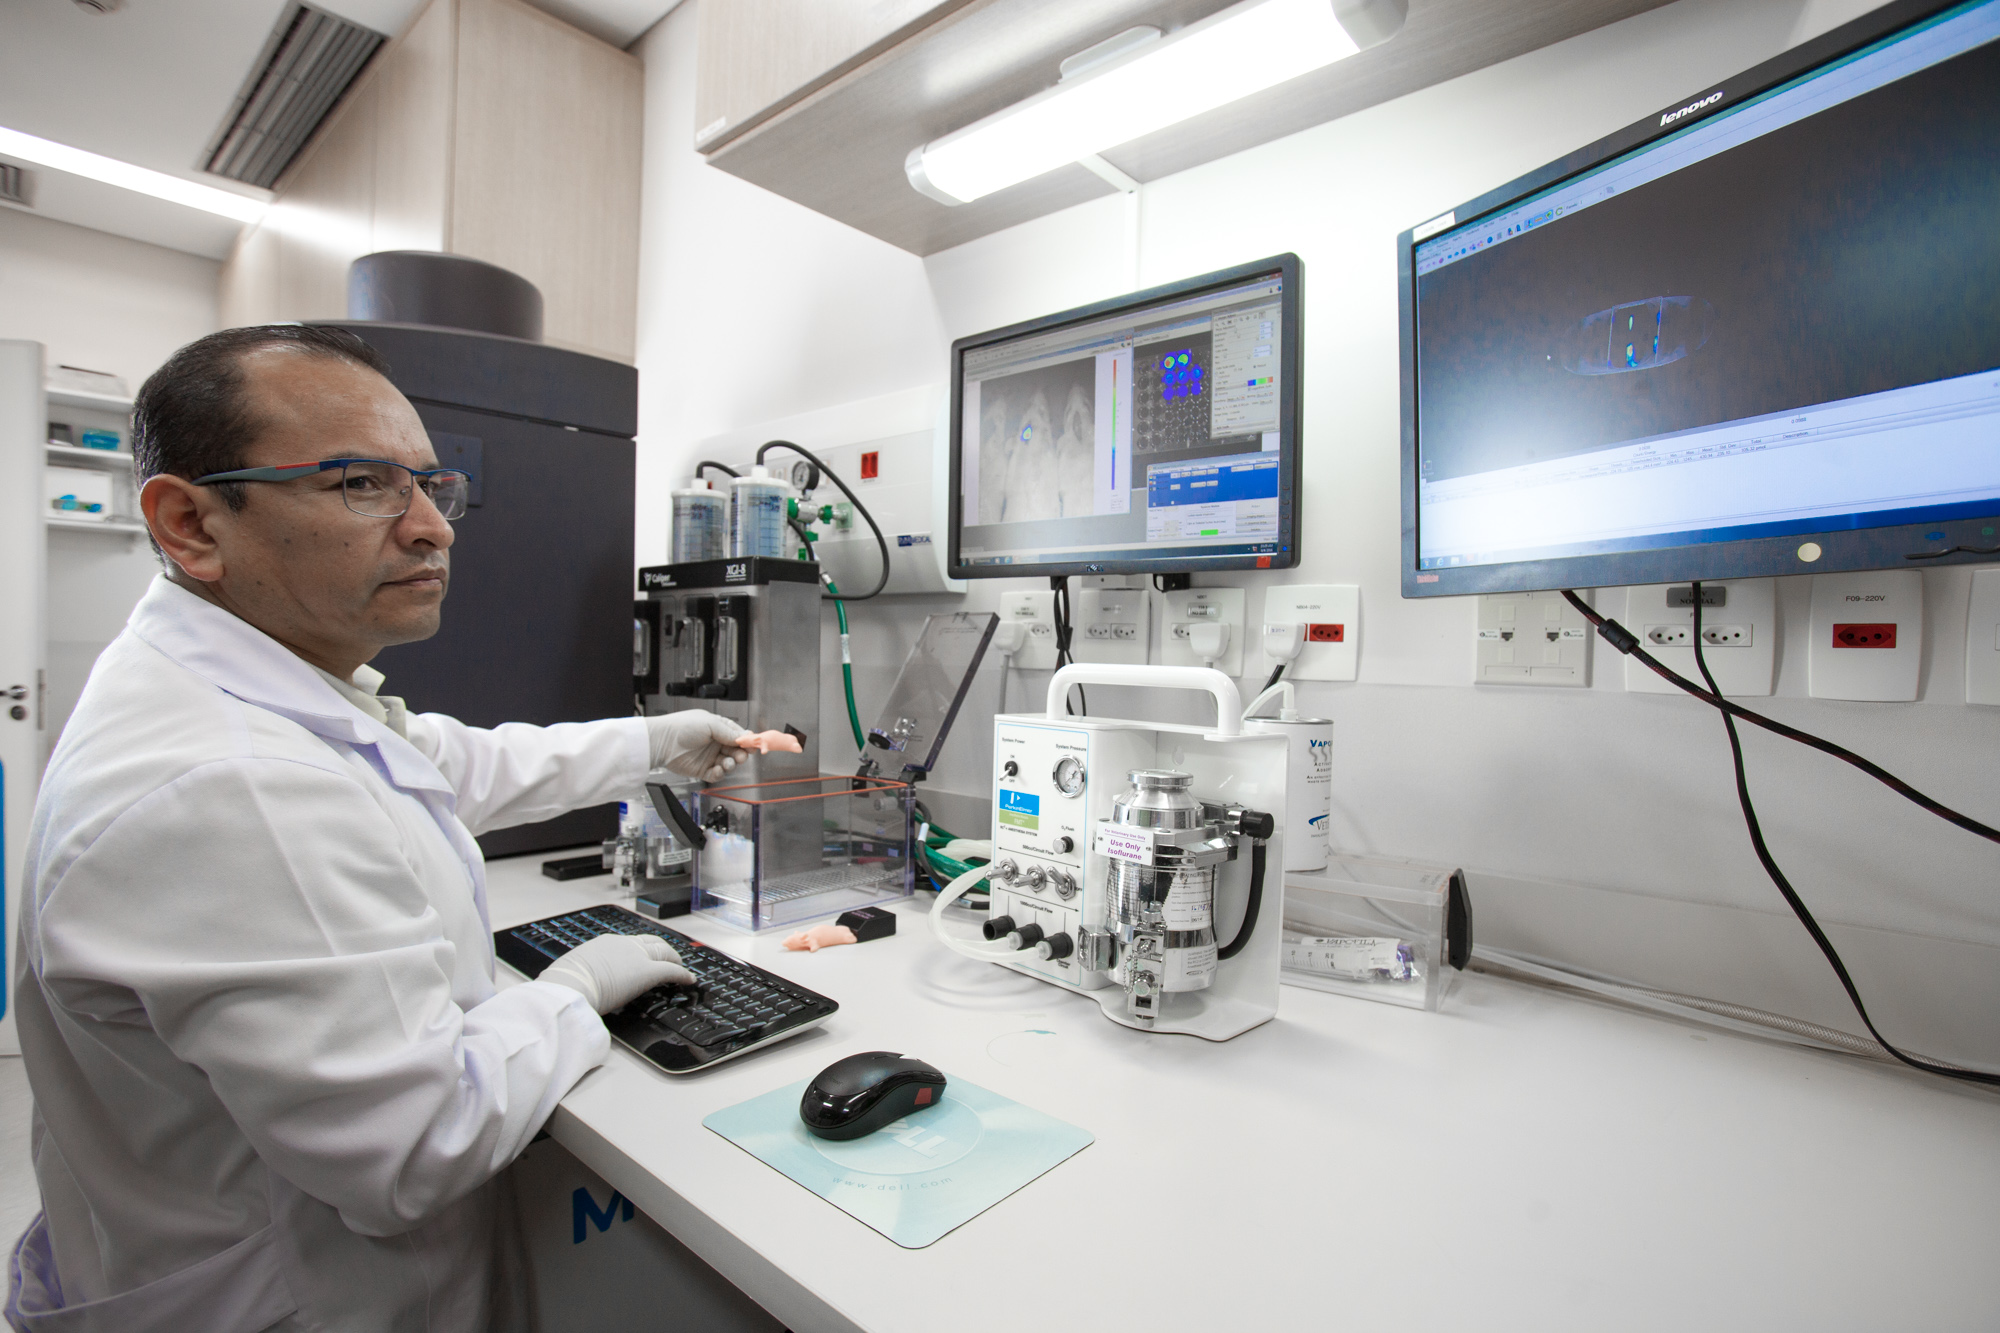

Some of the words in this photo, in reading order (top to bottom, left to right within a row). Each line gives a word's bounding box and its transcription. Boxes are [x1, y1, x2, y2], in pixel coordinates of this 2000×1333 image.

[1660, 91, 1724, 127] lenovo
[1004, 803, 1033, 814] PerkinElmer
[1111, 829, 1129, 838] Veterinary
[1110, 839, 1124, 847] Use
[1125, 842, 1141, 852] Only
[1107, 847, 1142, 861] Isoflurane
[832, 1176, 953, 1191] www.dell.com
